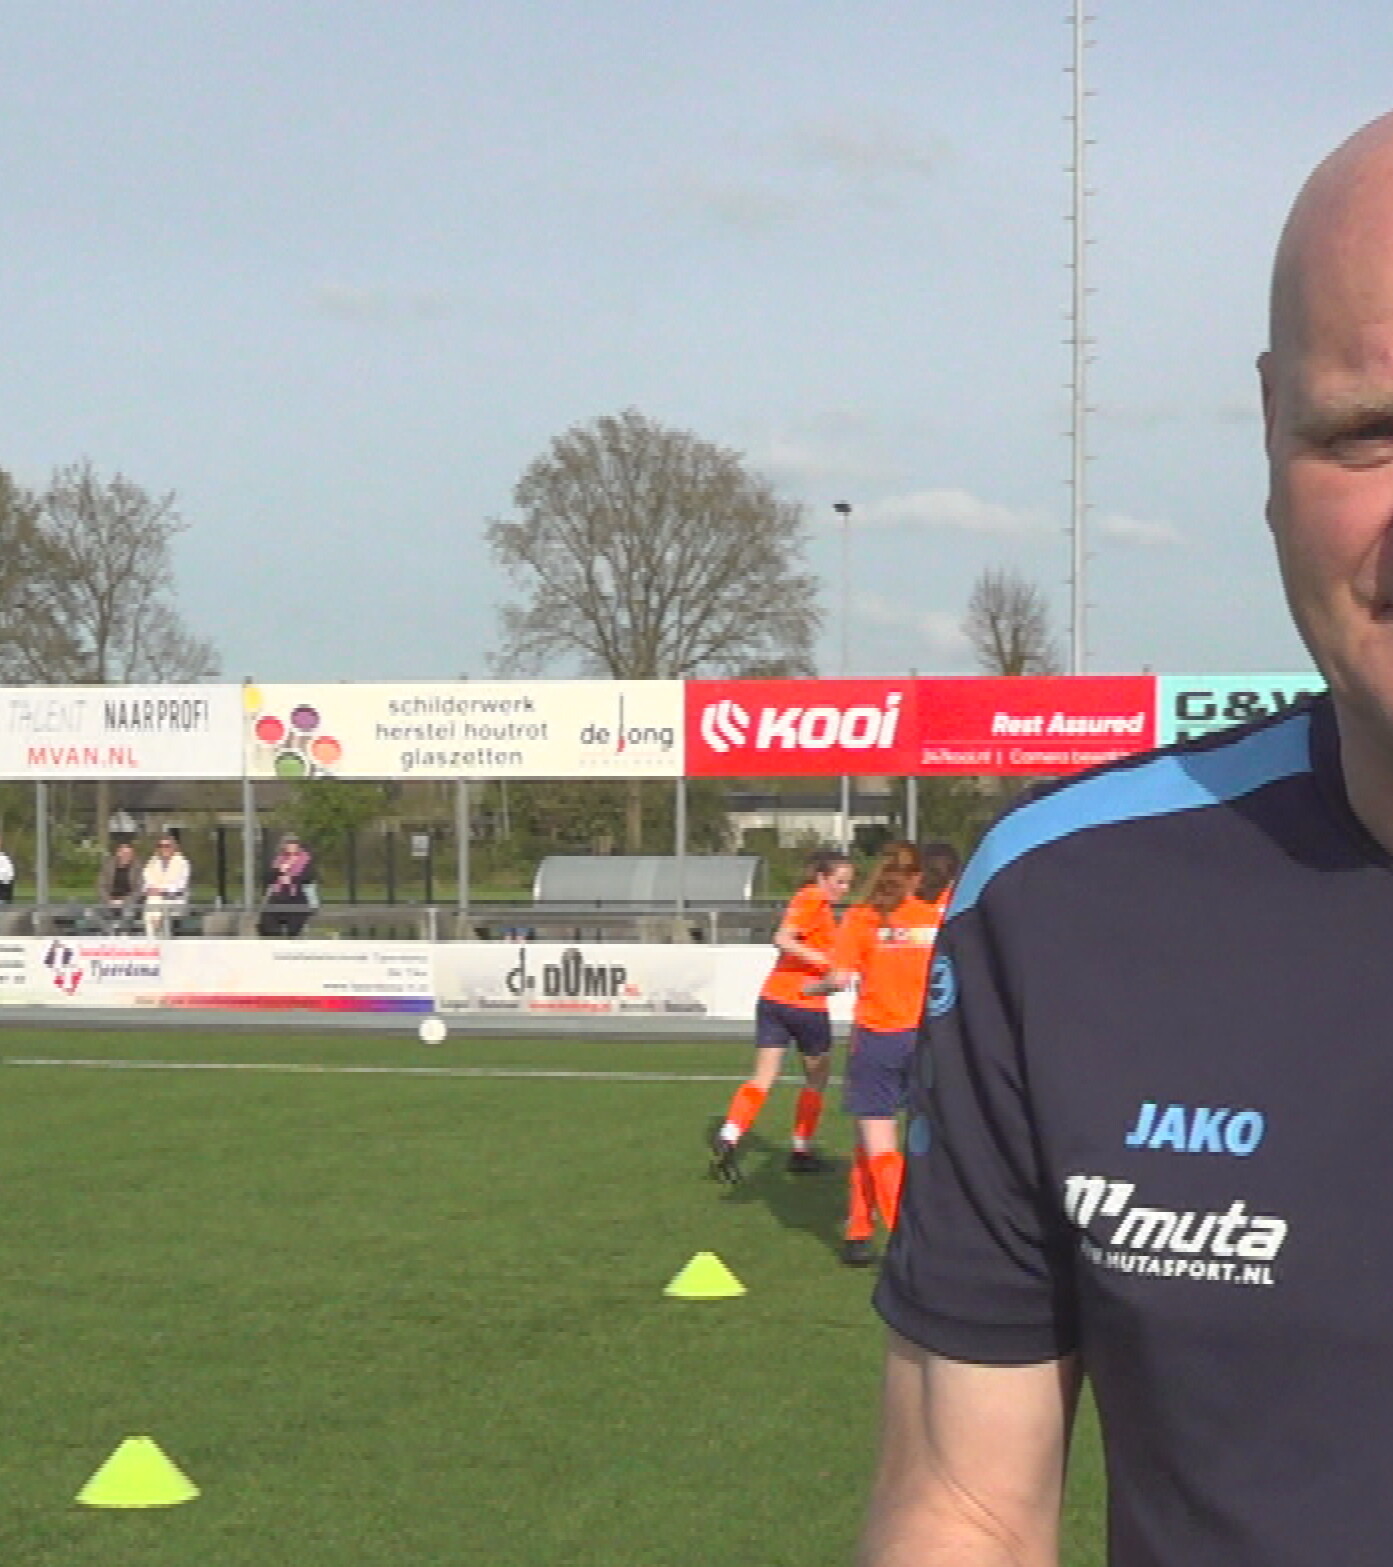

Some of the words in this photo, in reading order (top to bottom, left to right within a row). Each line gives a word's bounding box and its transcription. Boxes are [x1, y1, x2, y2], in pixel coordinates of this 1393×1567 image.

[388, 695, 534, 715] schilderwerk
[375, 722, 455, 741] herstel
[463, 722, 548, 741] houtrot
[580, 724, 610, 745] de
[992, 711, 1043, 735] Rest
[1046, 710, 1145, 735] Assured
[27, 746, 138, 767] MVAN.NL
[400, 746, 523, 772] glaszetten
[543, 948, 627, 997] DUMP
[1124, 1102, 1266, 1157] JAKO
[1109, 1200, 1288, 1261] muta
